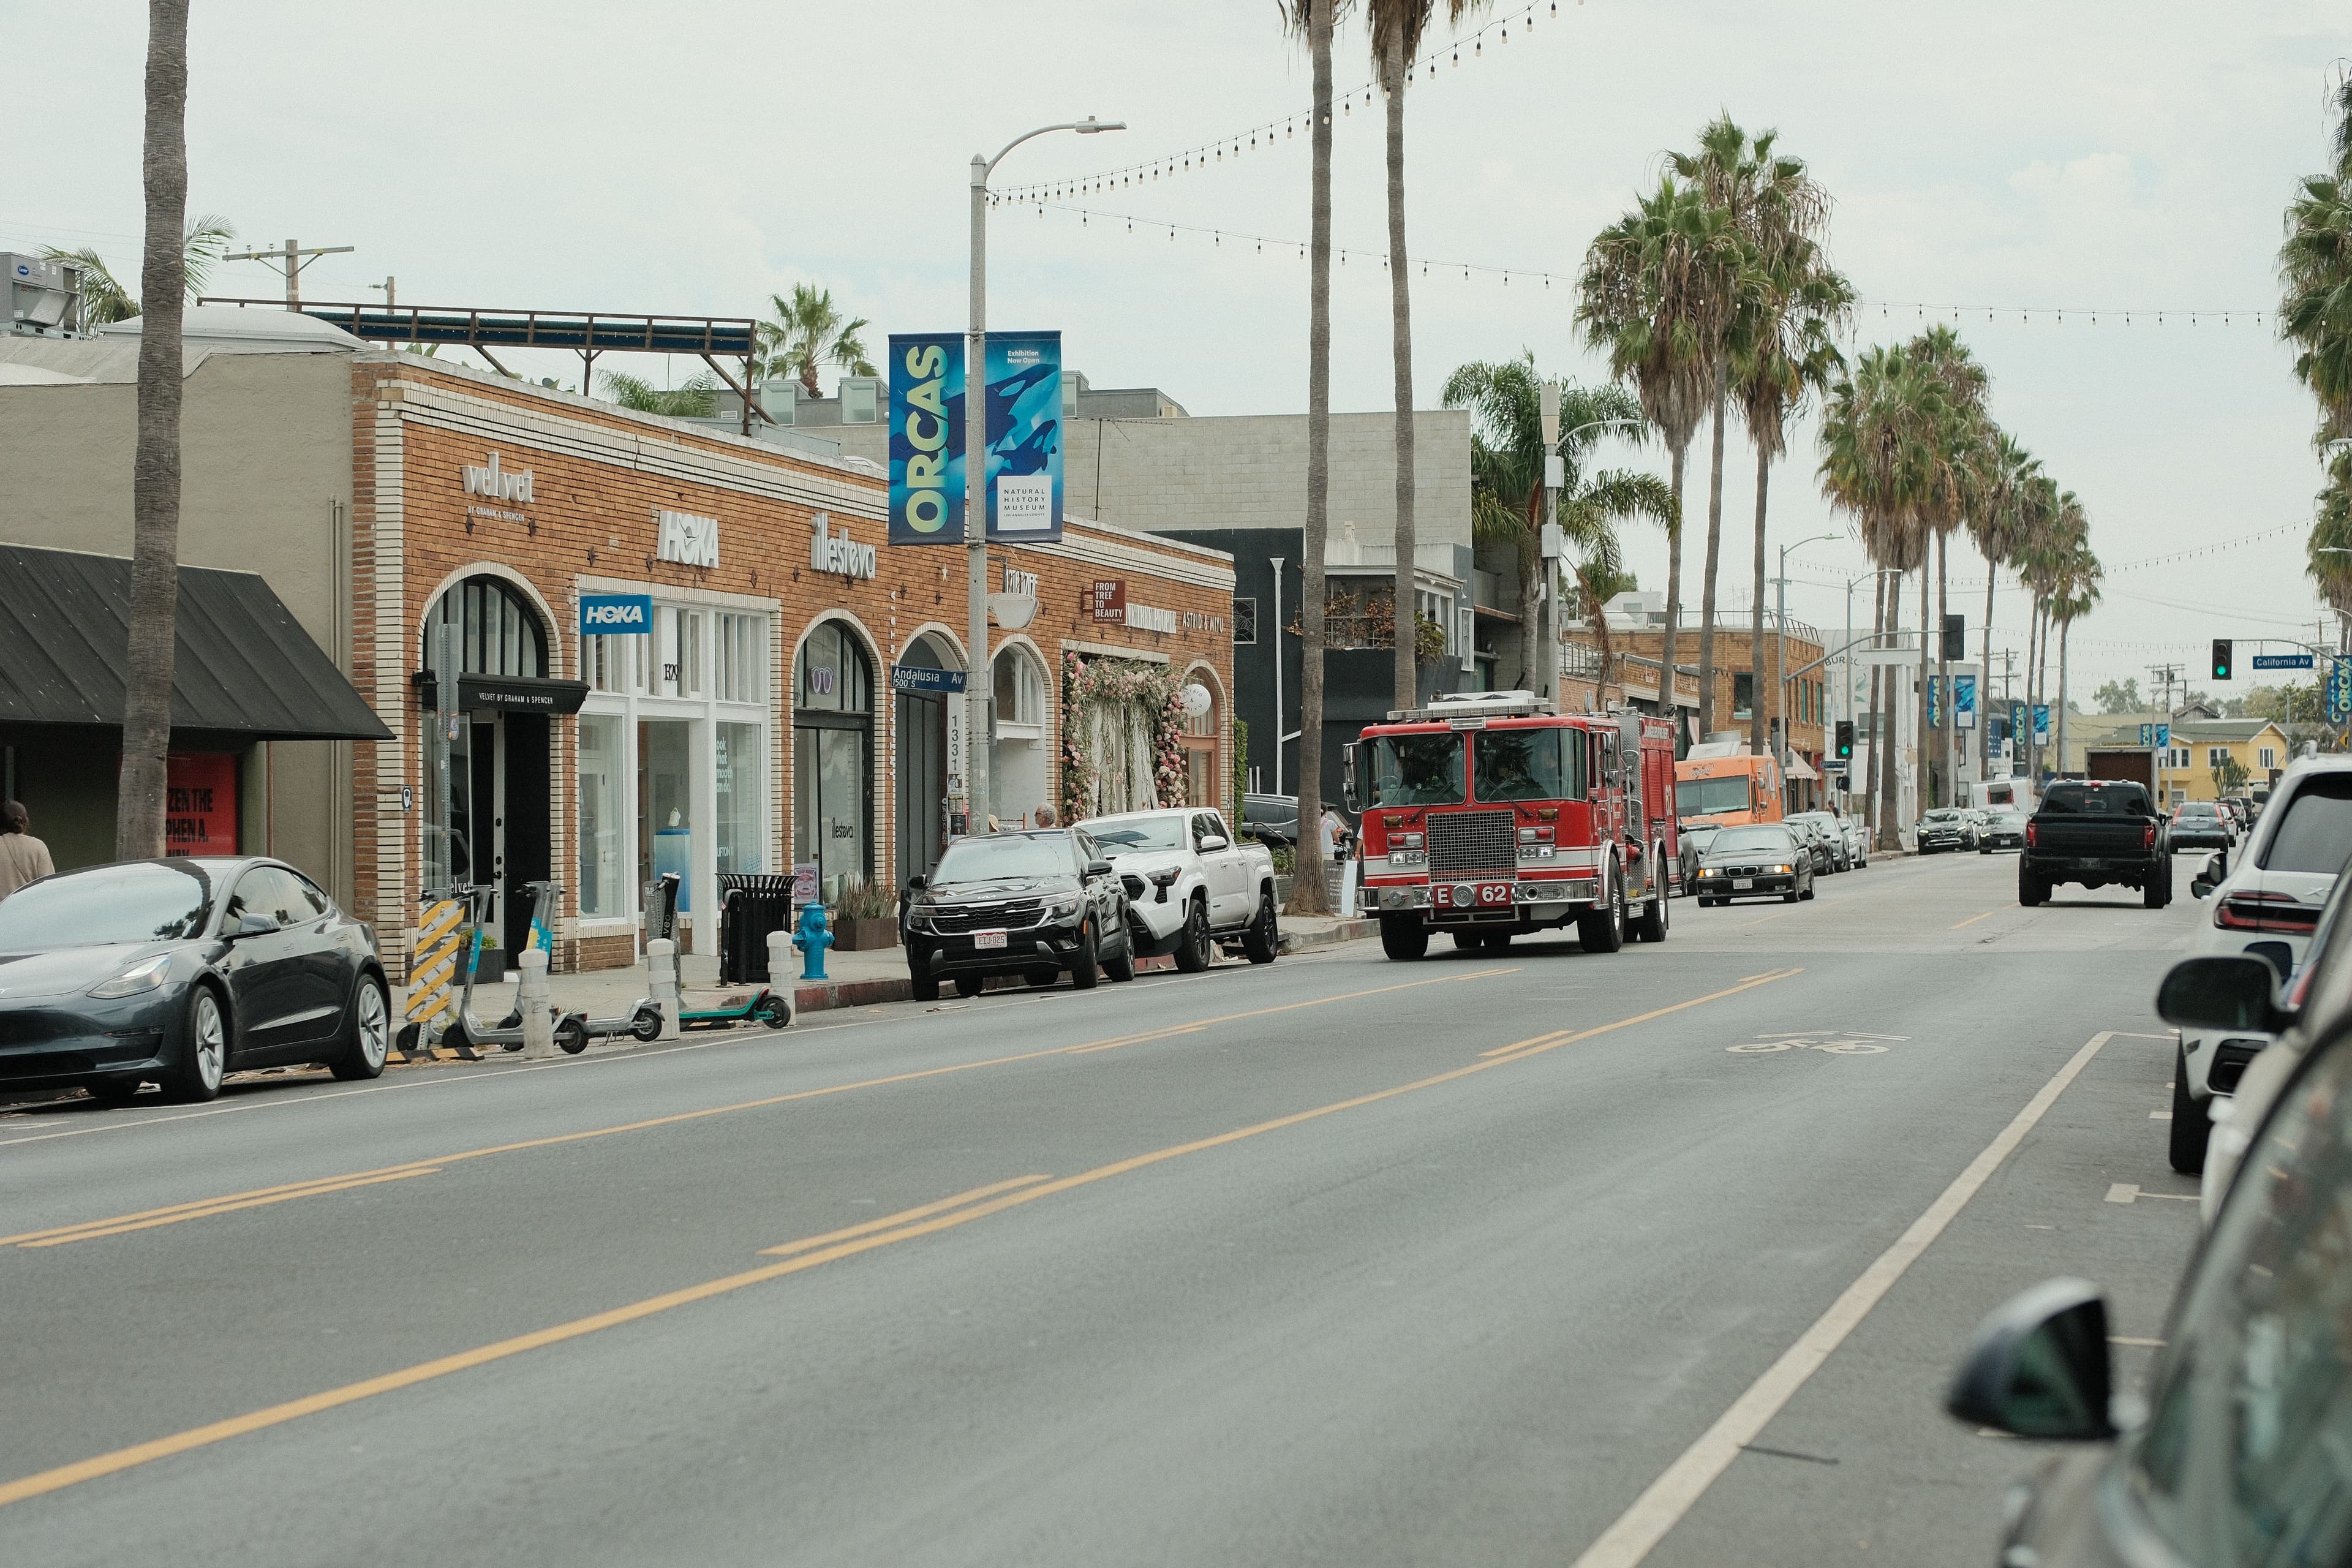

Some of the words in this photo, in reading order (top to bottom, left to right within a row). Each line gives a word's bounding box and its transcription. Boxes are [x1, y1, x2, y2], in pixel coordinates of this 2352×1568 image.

[906, 345, 949, 533] ORCAS
[460, 451, 535, 503] velvet
[476, 507, 497, 517] GRAHAM
[502, 511, 525, 521] SPENCER
[657, 510, 719, 568] HOKA
[810, 512, 876, 579] illesteva
[1095, 582, 1116, 591] FROM
[586, 605, 643, 624] HOKA
[1095, 609, 1123, 617] BEAUTY
[1182, 611, 1202, 630] ASTRID
[1204, 614, 1208, 630] &
[1209, 616, 1224, 633] MIYU
[2256, 658, 2296, 666] California
[893, 679, 908, 687] 1500
[894, 667, 940, 682] Andalusia
[951, 673, 963, 685] Av
[478, 692, 496, 701] VELVET
[505, 694, 525, 703] GRAHAM
[531, 696, 553, 704] SPENCER
[2016, 706, 2025, 745] ORCAS
[717, 737, 726, 750] ook
[717, 765, 733, 778] mooth
[167, 788, 190, 812] ZEN
[192, 788, 213, 812] THE
[1665, 784, 1673, 816] 62
[166, 818, 196, 843] PHEN
[831, 817, 853, 839] illesteva
[717, 846, 730, 857] LIFTON
[450, 876, 471, 893] elvet
[1438, 888, 1449, 903] E
[1482, 886, 1506, 902] 62
[663, 914, 671, 934] veo
